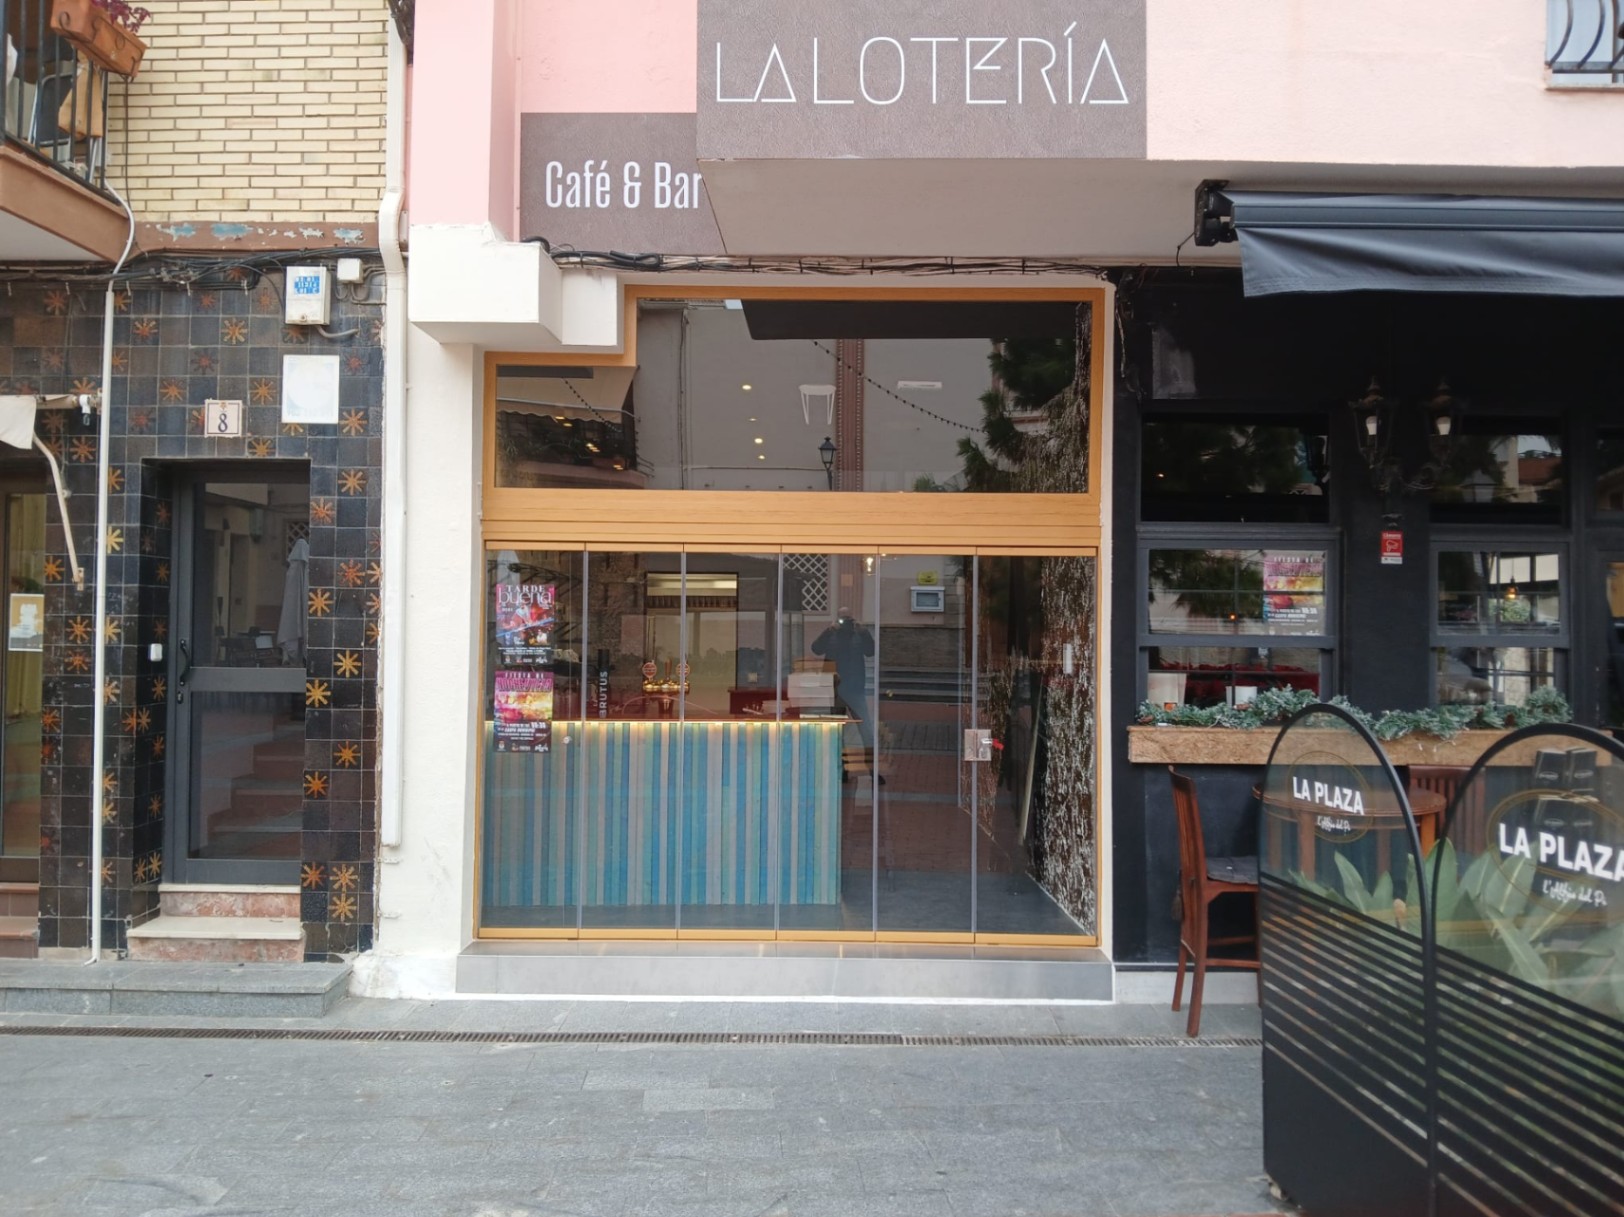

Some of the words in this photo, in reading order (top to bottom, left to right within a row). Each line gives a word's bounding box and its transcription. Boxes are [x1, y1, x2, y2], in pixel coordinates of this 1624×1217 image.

[716, 42, 797, 104] LA
[813, 21, 1130, 105] LOTERÍA
[546, 160, 610, 208] Café
[623, 161, 642, 208] &
[654, 162, 702, 209] Bar
[218, 413, 228, 432] 8
[498, 588, 551, 604] buena
[599, 671, 608, 719] BRUTUS
[1293, 776, 1312, 802] LA
[1314, 781, 1365, 816] PLAZA
[1499, 823, 1532, 859] LA
